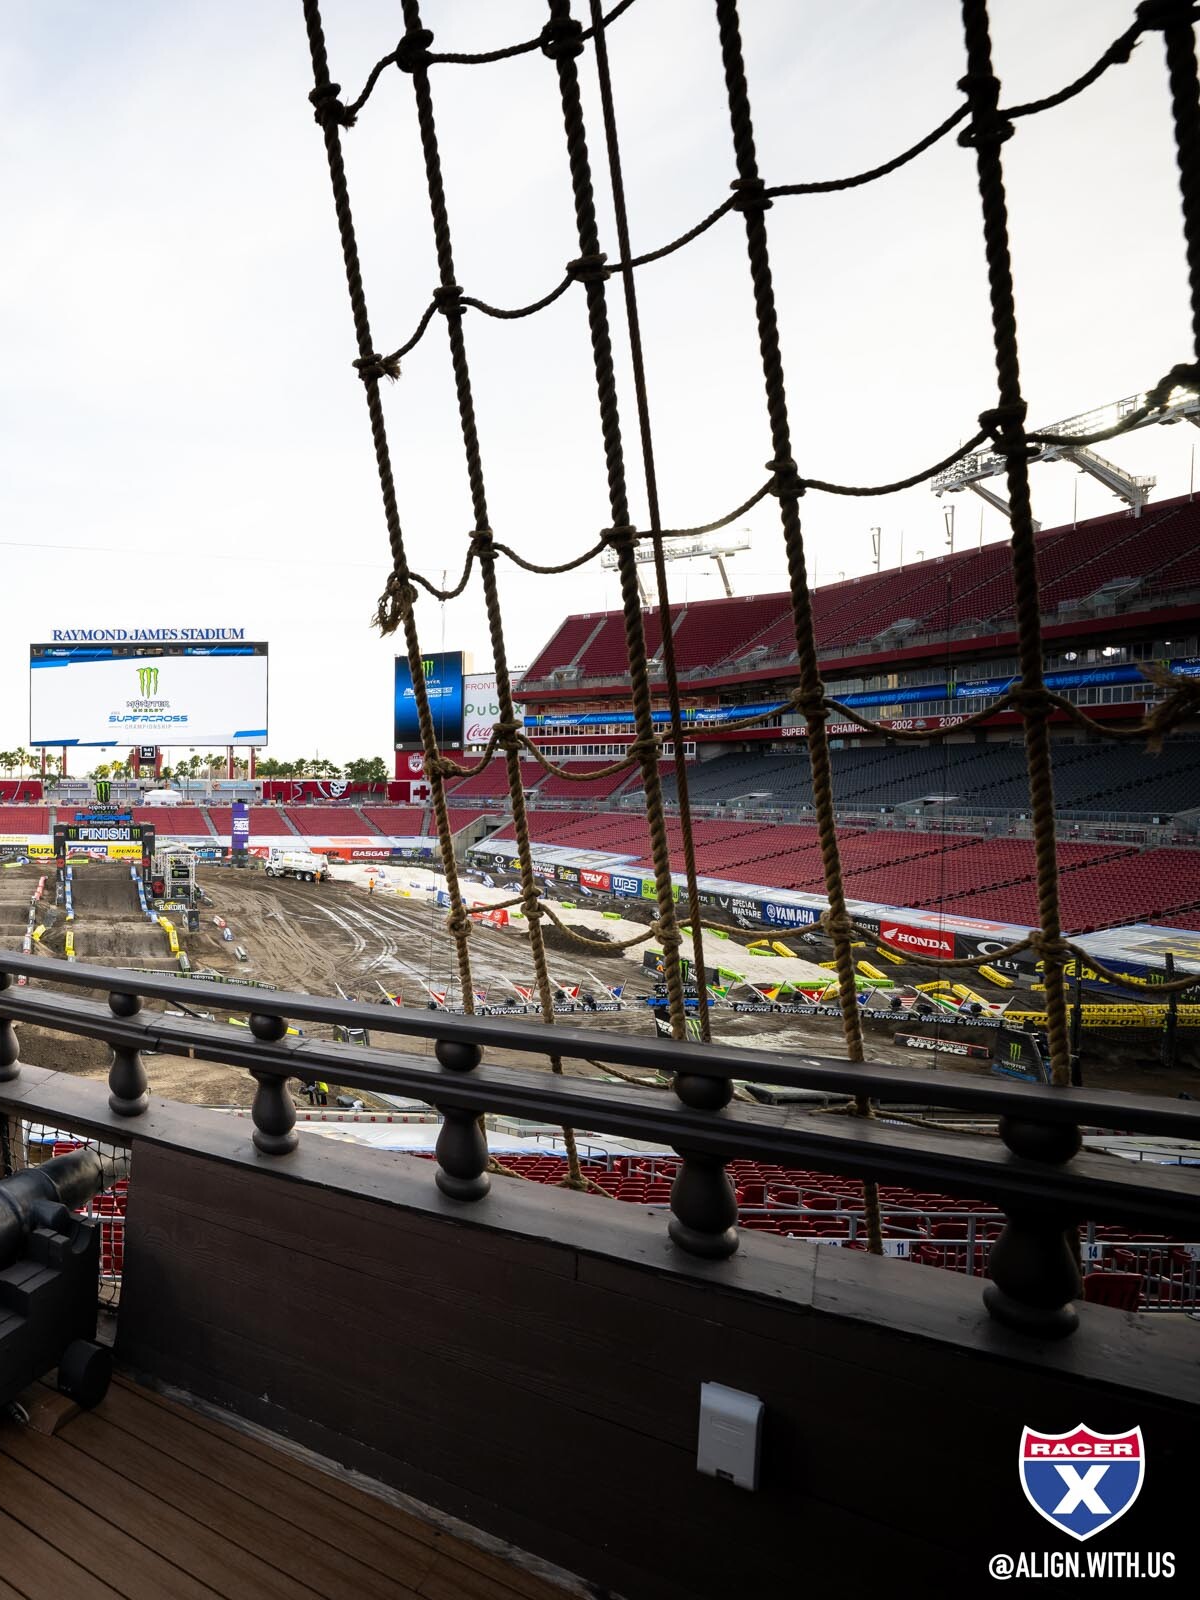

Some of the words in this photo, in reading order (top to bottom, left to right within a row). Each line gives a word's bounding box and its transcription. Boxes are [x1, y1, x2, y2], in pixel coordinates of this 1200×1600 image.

[53, 628, 128, 641] RAYMOND
[129, 628, 179, 641] JAMES
[181, 628, 245, 640] STADIUM
[1056, 676, 1081, 686] WISE
[1082, 671, 1116, 685] EVENT
[126, 699, 170, 709] MONSTER
[108, 715, 188, 723] SUPERCROSS
[781, 727, 806, 738] SUPER
[892, 719, 913, 730] 2002
[939, 716, 963, 728] 2020
[78, 828, 131, 841] FINISH
[613, 876, 638, 894] WPS
[732, 898, 757, 910] SPECIAL
[732, 906, 762, 919] WARFARE
[775, 906, 815, 924] YAMAHA
[898, 933, 952, 951] HONDA
[897, 1242, 904, 1256] 11
[1088, 1246, 1098, 1259] 14
